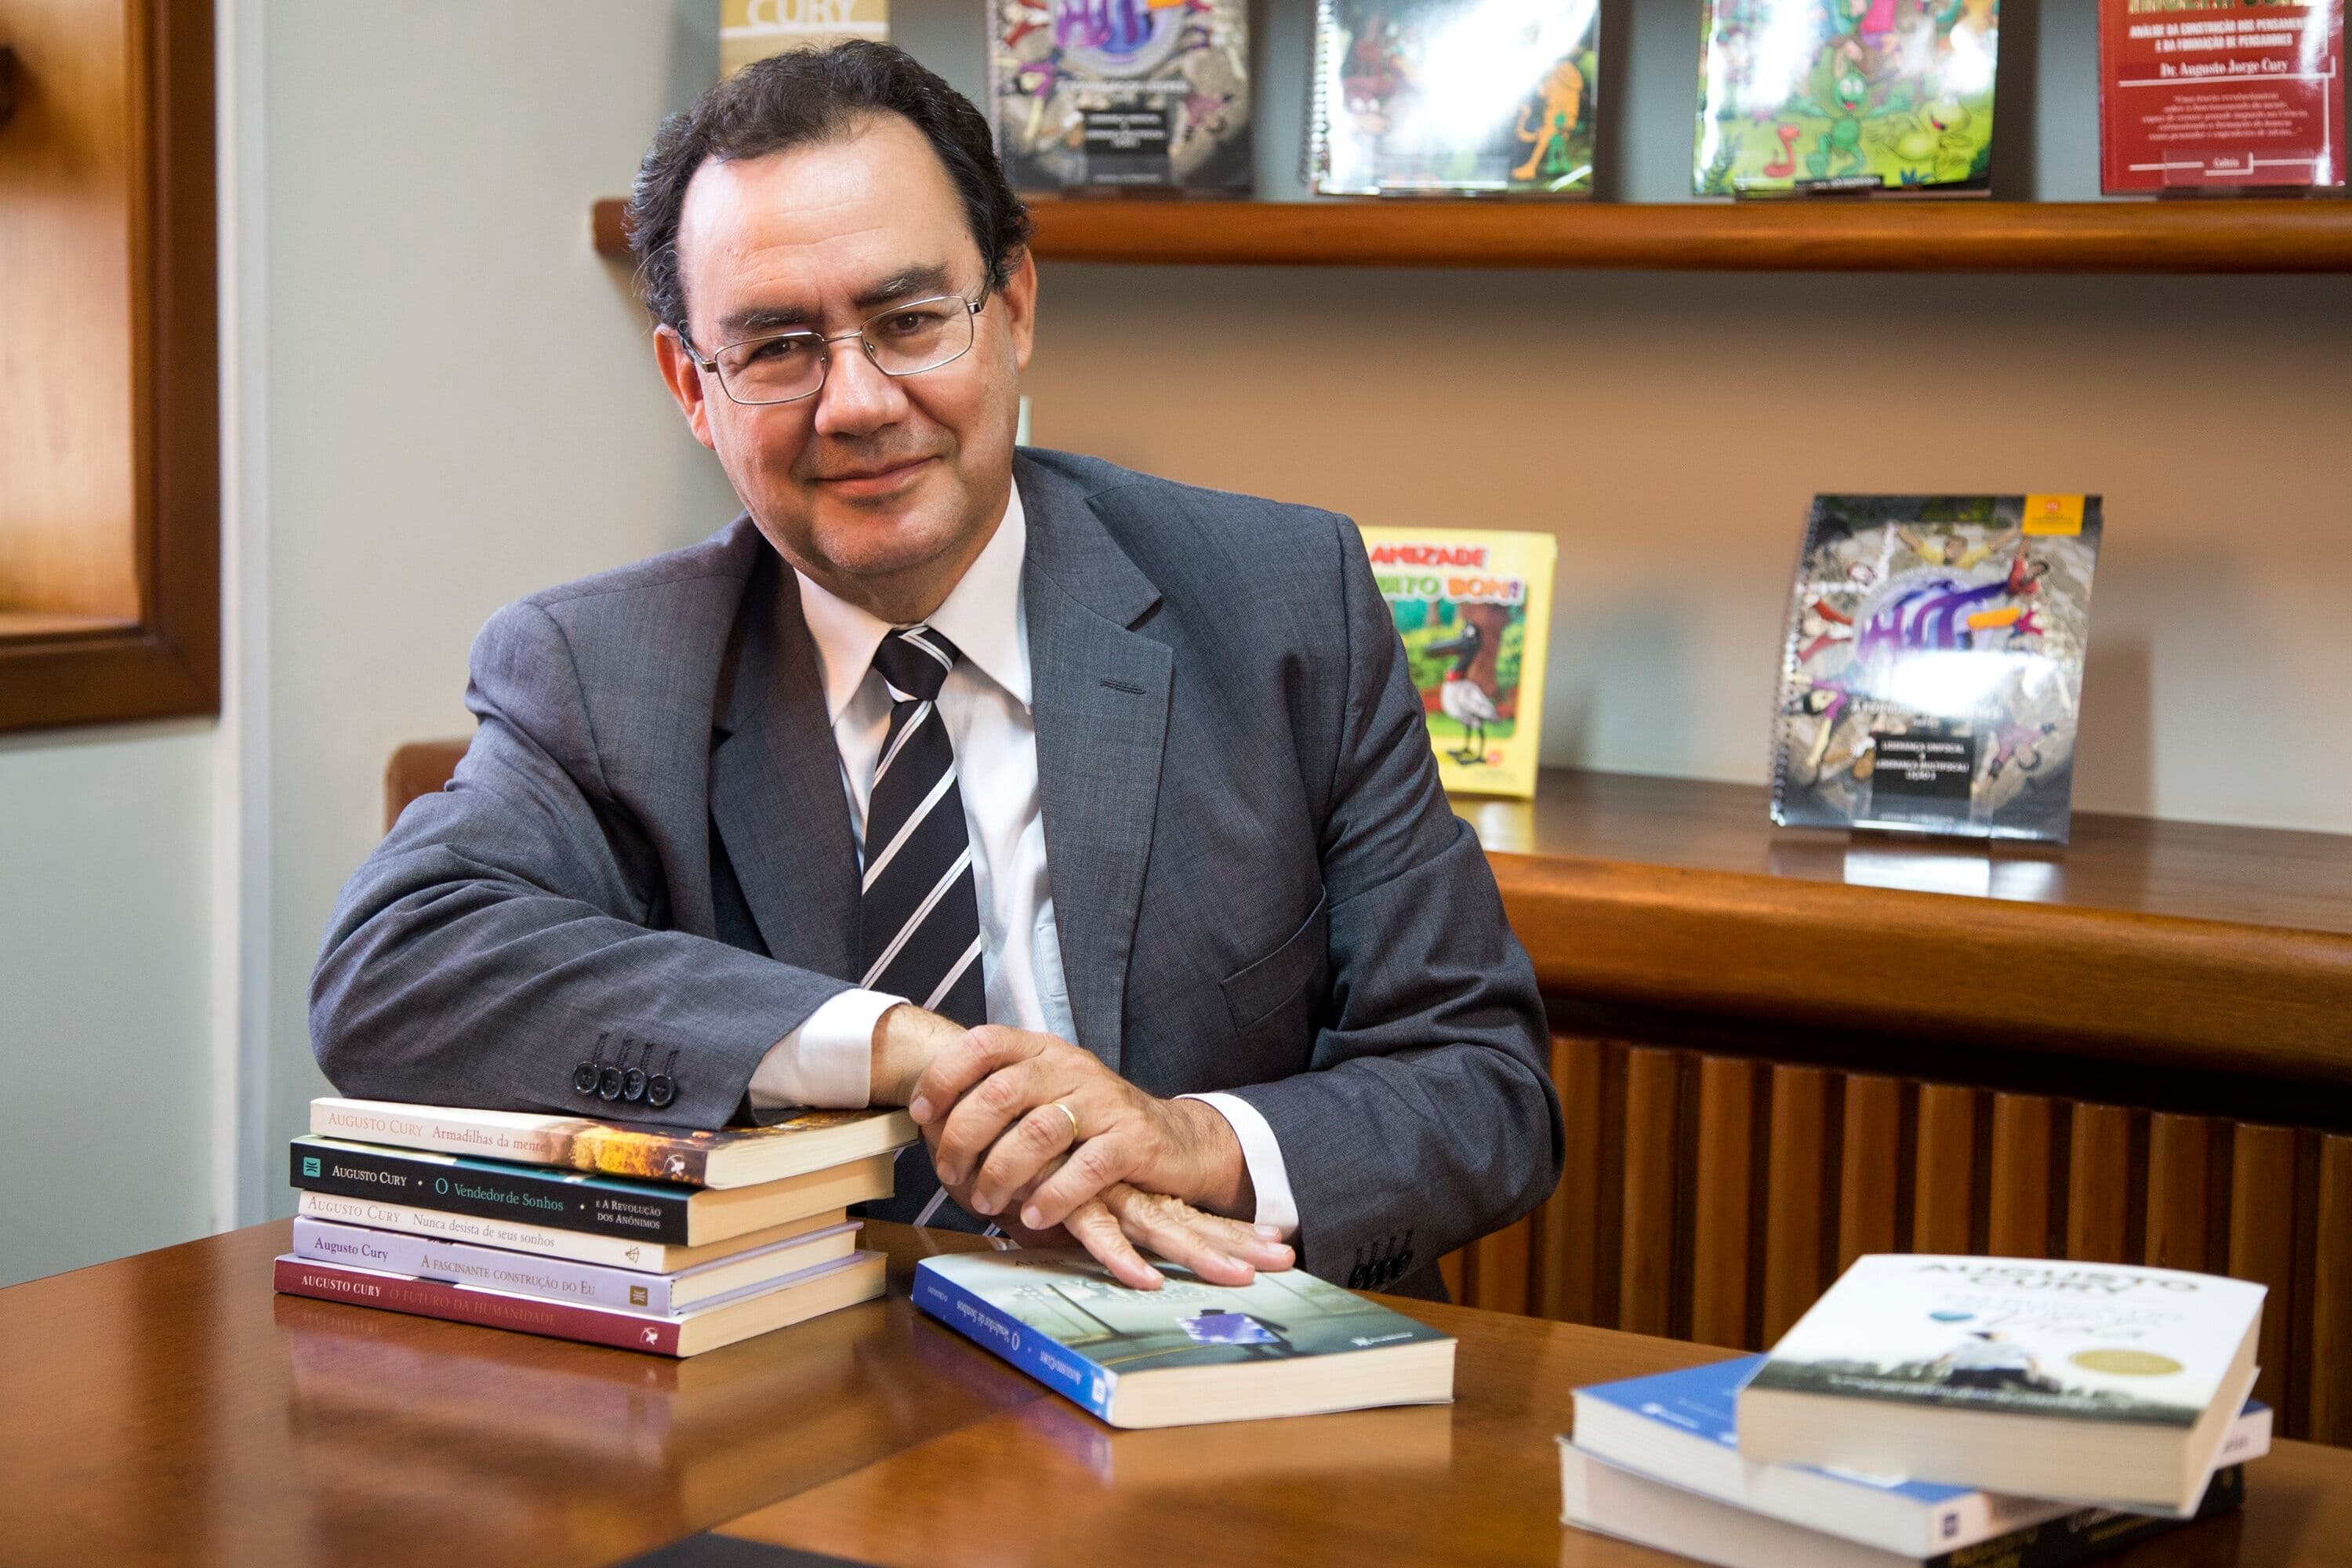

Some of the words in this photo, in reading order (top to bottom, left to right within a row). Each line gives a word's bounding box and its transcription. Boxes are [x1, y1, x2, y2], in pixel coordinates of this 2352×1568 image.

[747, 0, 858, 24] CURY
[2179, 61, 2226, 78] Augusto
[2228, 58, 2259, 74] Jorge
[2260, 56, 2288, 73] Cury
[328, 1112, 386, 1132] AUGUSTO
[390, 1119, 423, 1136] CURY
[432, 1125, 493, 1146] Armadilhas
[497, 1134, 510, 1149] da
[513, 1141, 546, 1153] mente
[332, 1164, 376, 1183] AUGUSTO
[379, 1171, 407, 1187] CURY
[435, 1178, 448, 1196] O
[455, 1184, 504, 1203] Vendedor
[506, 1190, 519, 1204] de
[522, 1193, 564, 1211] Sonhos
[597, 1212, 614, 1224] DOS
[615, 1214, 660, 1230] ANÔNIMOS
[602, 1200, 609, 1210] A
[612, 1200, 662, 1217] REVOLUÇÃO
[307, 1196, 362, 1217] AUGUSTO
[367, 1204, 401, 1224] CURY
[413, 1213, 445, 1230] Nunca
[448, 1220, 480, 1236] desista
[482, 1225, 495, 1238] de
[497, 1230, 517, 1242] seus
[520, 1232, 555, 1248] sonhos
[314, 1236, 358, 1255] Augusto
[361, 1243, 389, 1262] Cury
[421, 1254, 430, 1269] A
[433, 1258, 490, 1279] FASCINANTE
[493, 1268, 558, 1291] CONSTRUÇÃO
[561, 1280, 577, 1293] DO
[580, 1280, 596, 1295] EU
[1917, 1264, 2201, 1292] AUGUSTO
[1969, 1276, 2129, 1294] CURY
[301, 1275, 350, 1292] AUGUSTO
[353, 1283, 382, 1298] CURY
[403, 1290, 450, 1308] FUTURO
[454, 1298, 470, 1312] DA
[474, 1301, 556, 1327] HUMANIDADE
[1011, 1332, 1020, 1351] O
